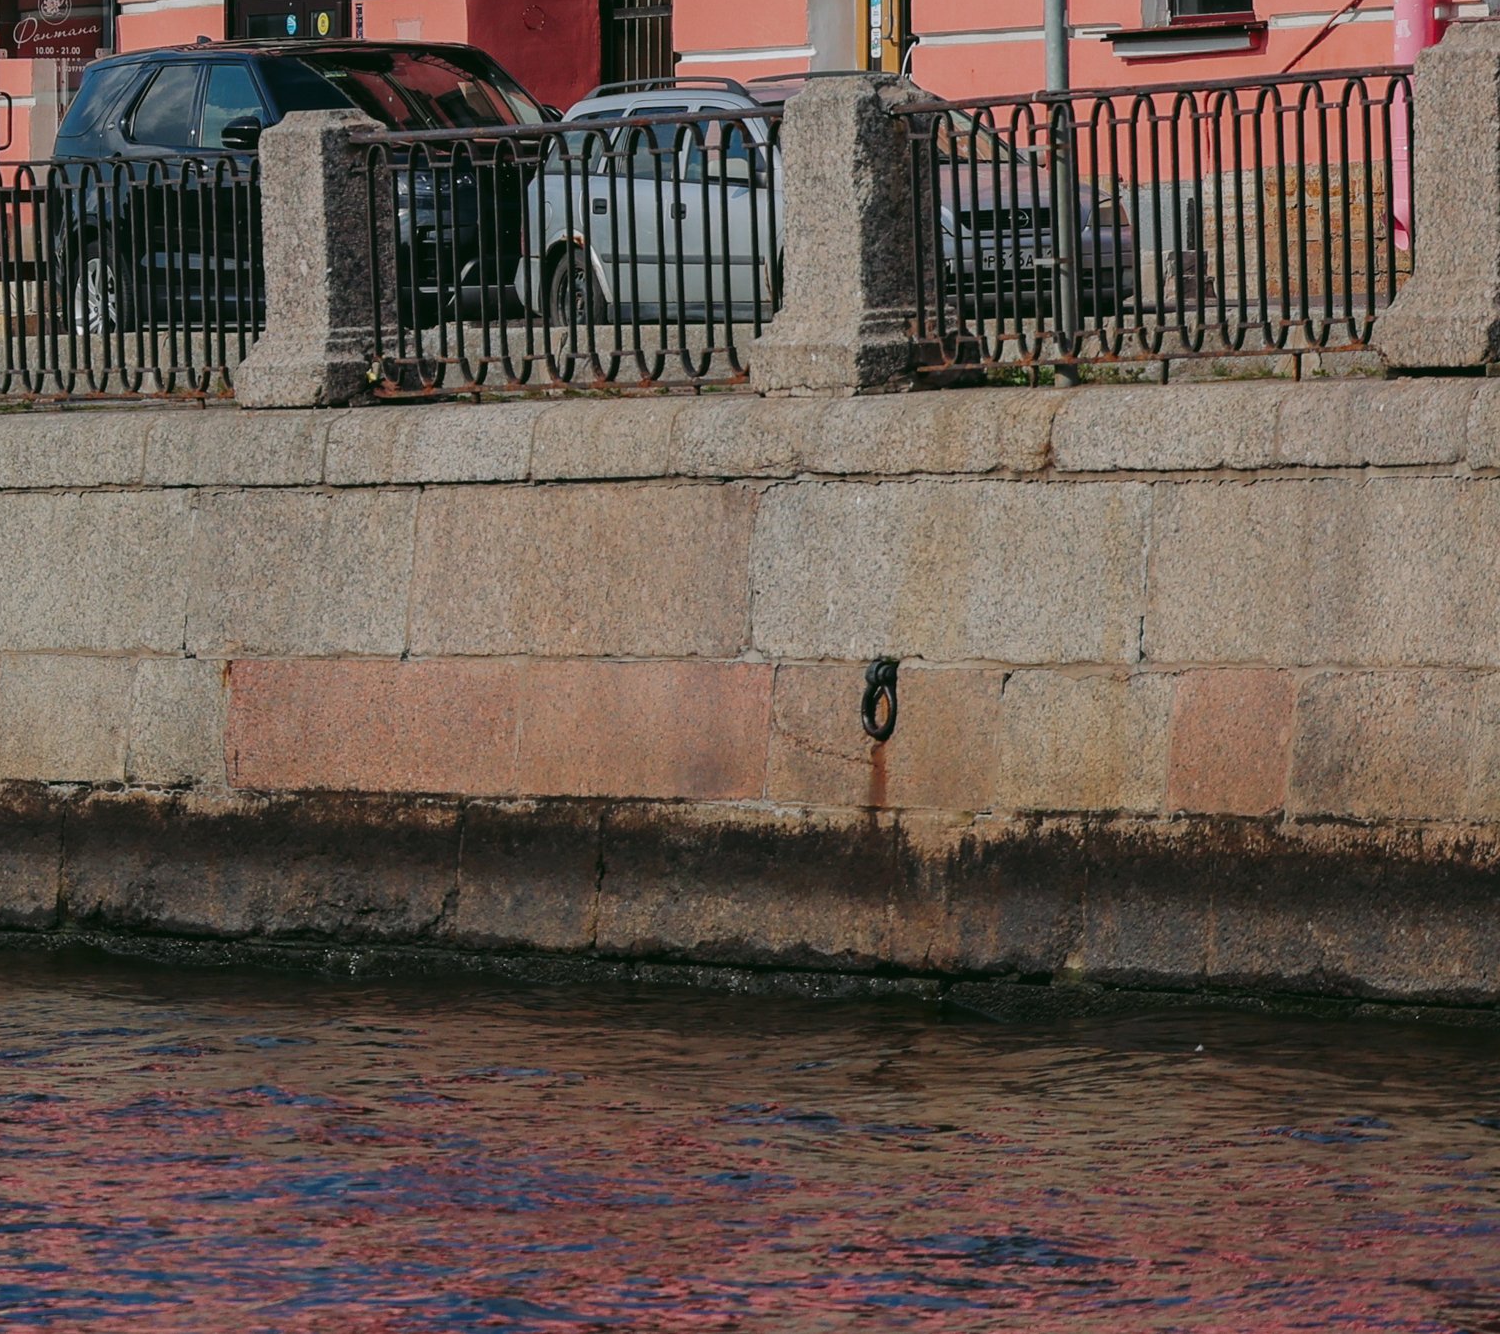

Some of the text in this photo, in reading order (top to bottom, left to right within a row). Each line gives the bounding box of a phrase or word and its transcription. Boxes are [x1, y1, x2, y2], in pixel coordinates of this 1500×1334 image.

[13, 14, 100, 49] Фонтана
[35, 47, 55, 55] 10.00
[61, 46, 80, 55] 21.00
